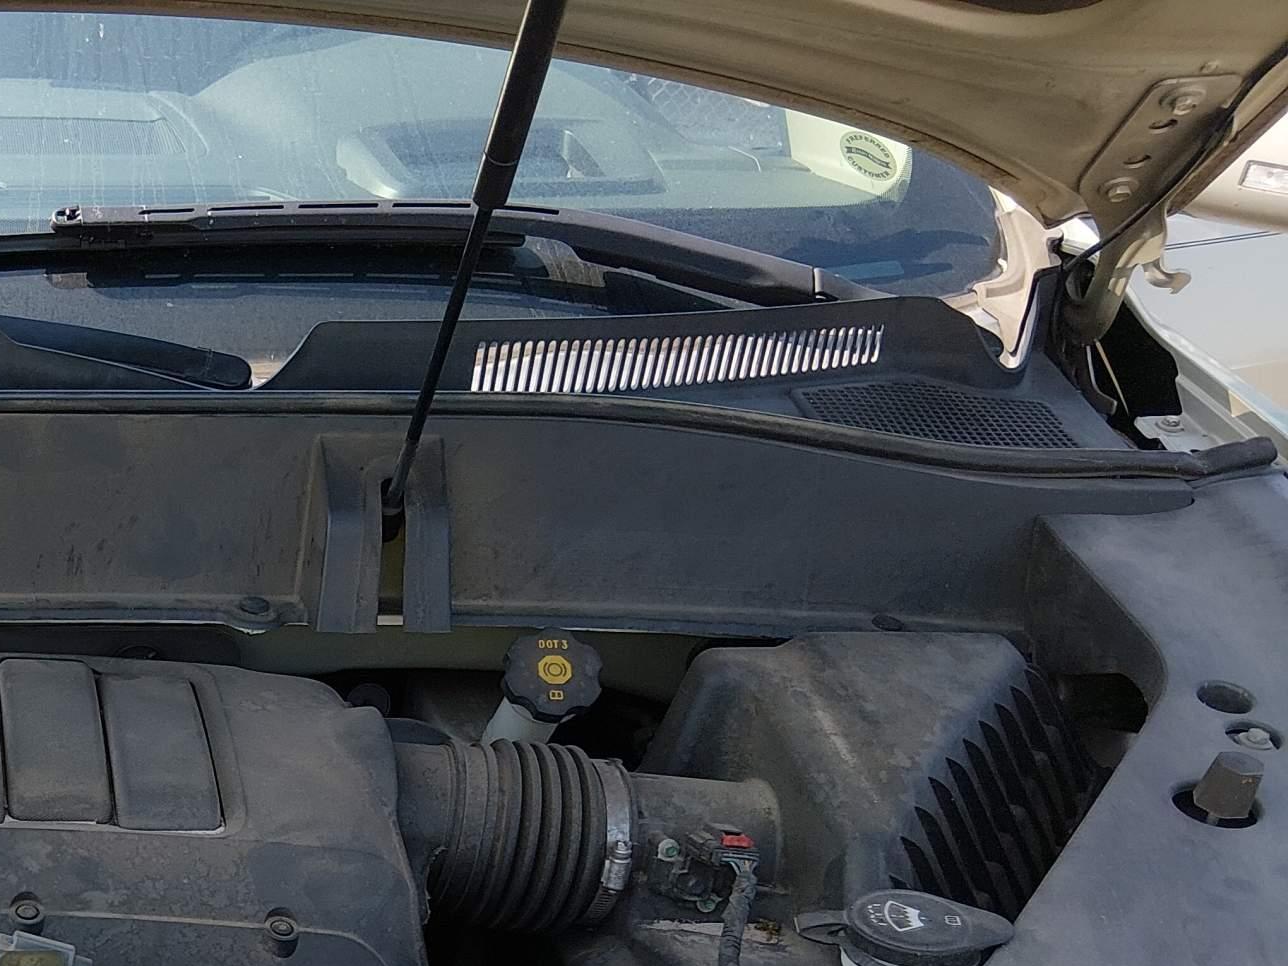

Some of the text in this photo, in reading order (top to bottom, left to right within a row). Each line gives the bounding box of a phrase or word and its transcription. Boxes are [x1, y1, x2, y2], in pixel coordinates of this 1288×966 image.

[845, 134, 891, 159] PREFERRED
[847, 155, 891, 178] CUSTOMER
[538, 639, 569, 650] DOT 3
